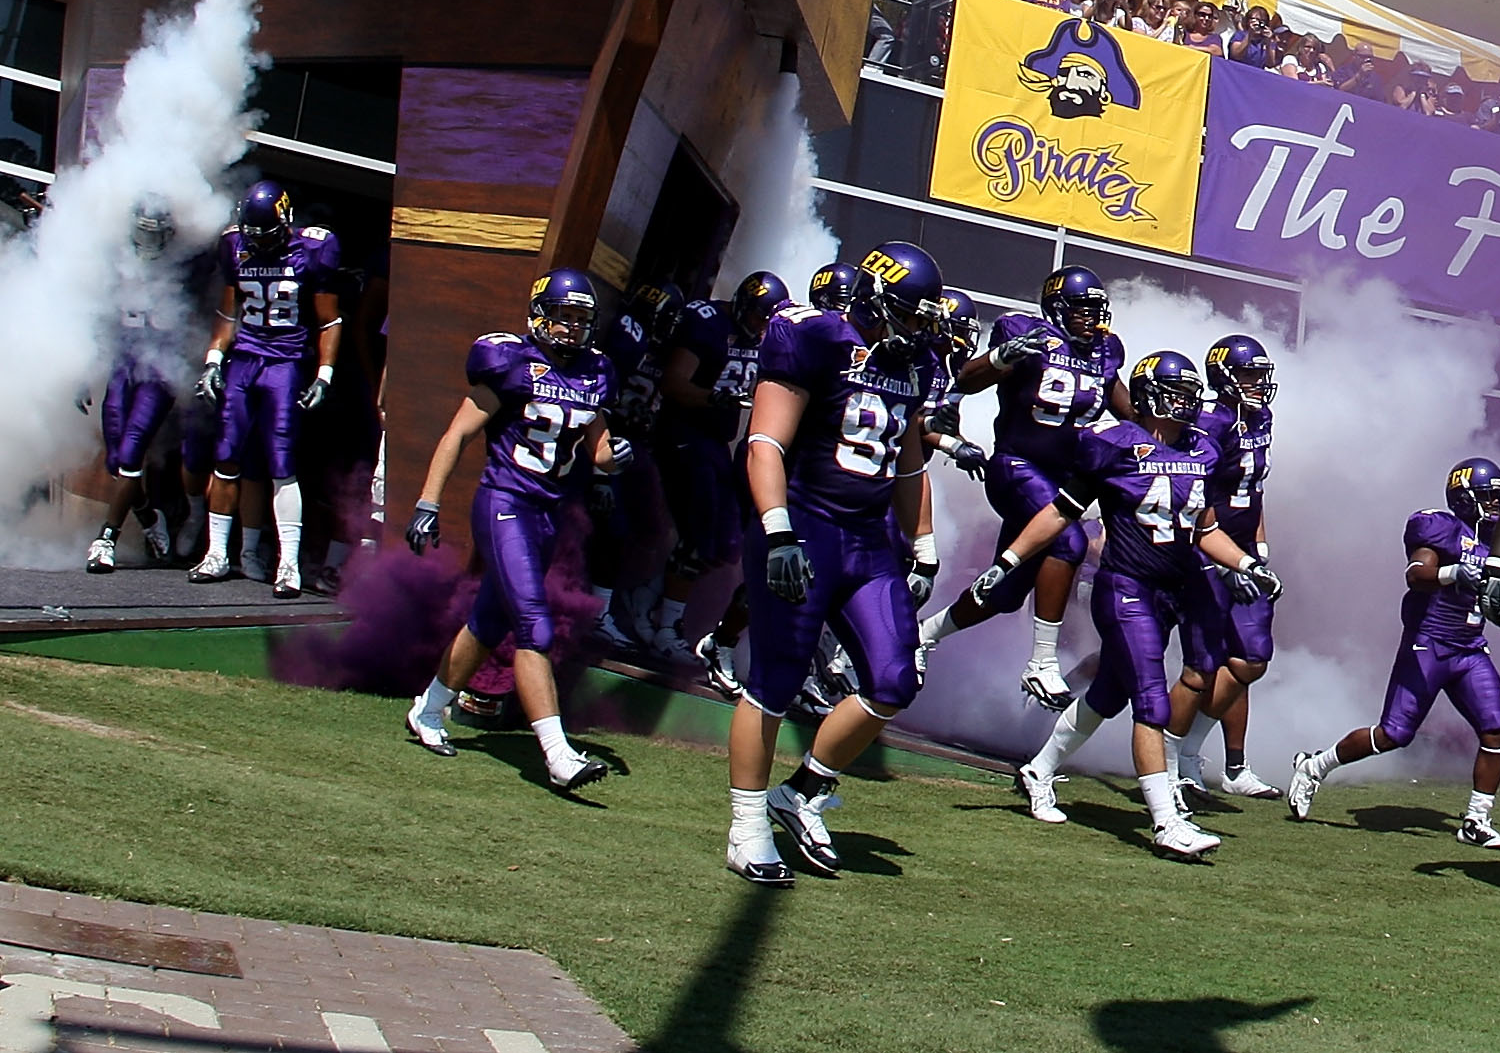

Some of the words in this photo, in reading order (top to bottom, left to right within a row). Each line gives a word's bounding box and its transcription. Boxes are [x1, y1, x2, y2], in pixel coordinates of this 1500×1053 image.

[972, 116, 1156, 222] Pirates
[1231, 103, 1407, 258] The
[860, 249, 910, 285] ECU
[238, 280, 300, 327] 28
[533, 382, 557, 400] EAST
[1032, 367, 1105, 428] 97
[513, 401, 598, 477] 37
[1138, 461, 1164, 474] EAST
[1135, 475, 1206, 544] 44
